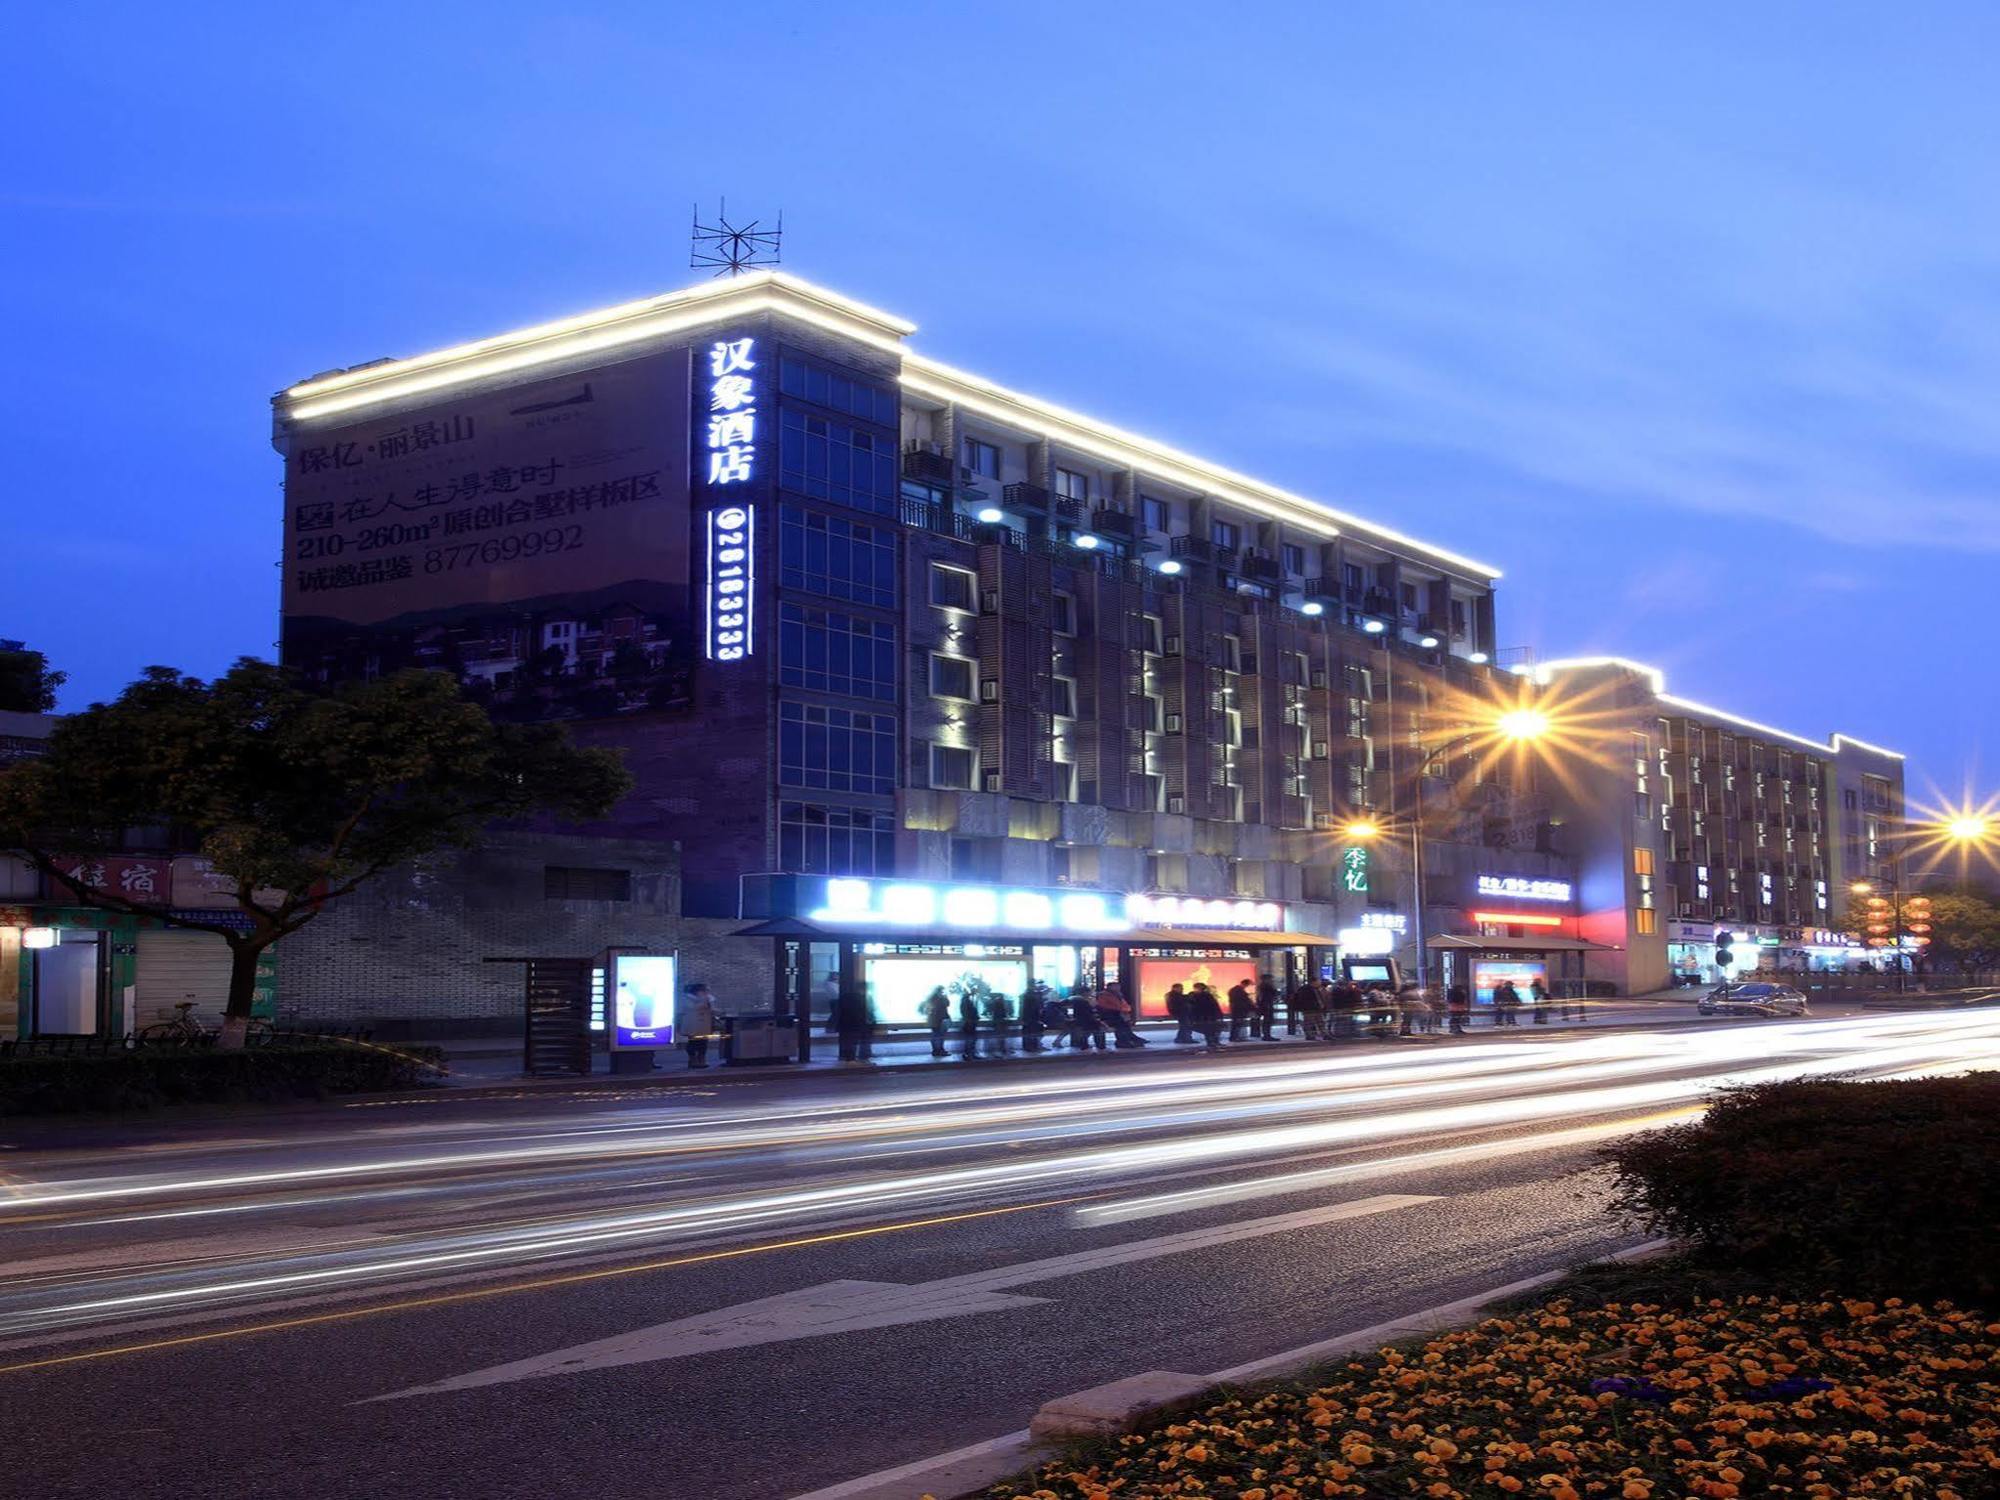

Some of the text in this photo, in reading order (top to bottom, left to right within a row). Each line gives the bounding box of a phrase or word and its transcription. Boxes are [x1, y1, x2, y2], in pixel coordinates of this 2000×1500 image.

[300, 414, 475, 474] 保亿·丽景山
[707, 337, 756, 485] 汉象酒店
[296, 523, 585, 593] 诚邀品鉴 87769992
